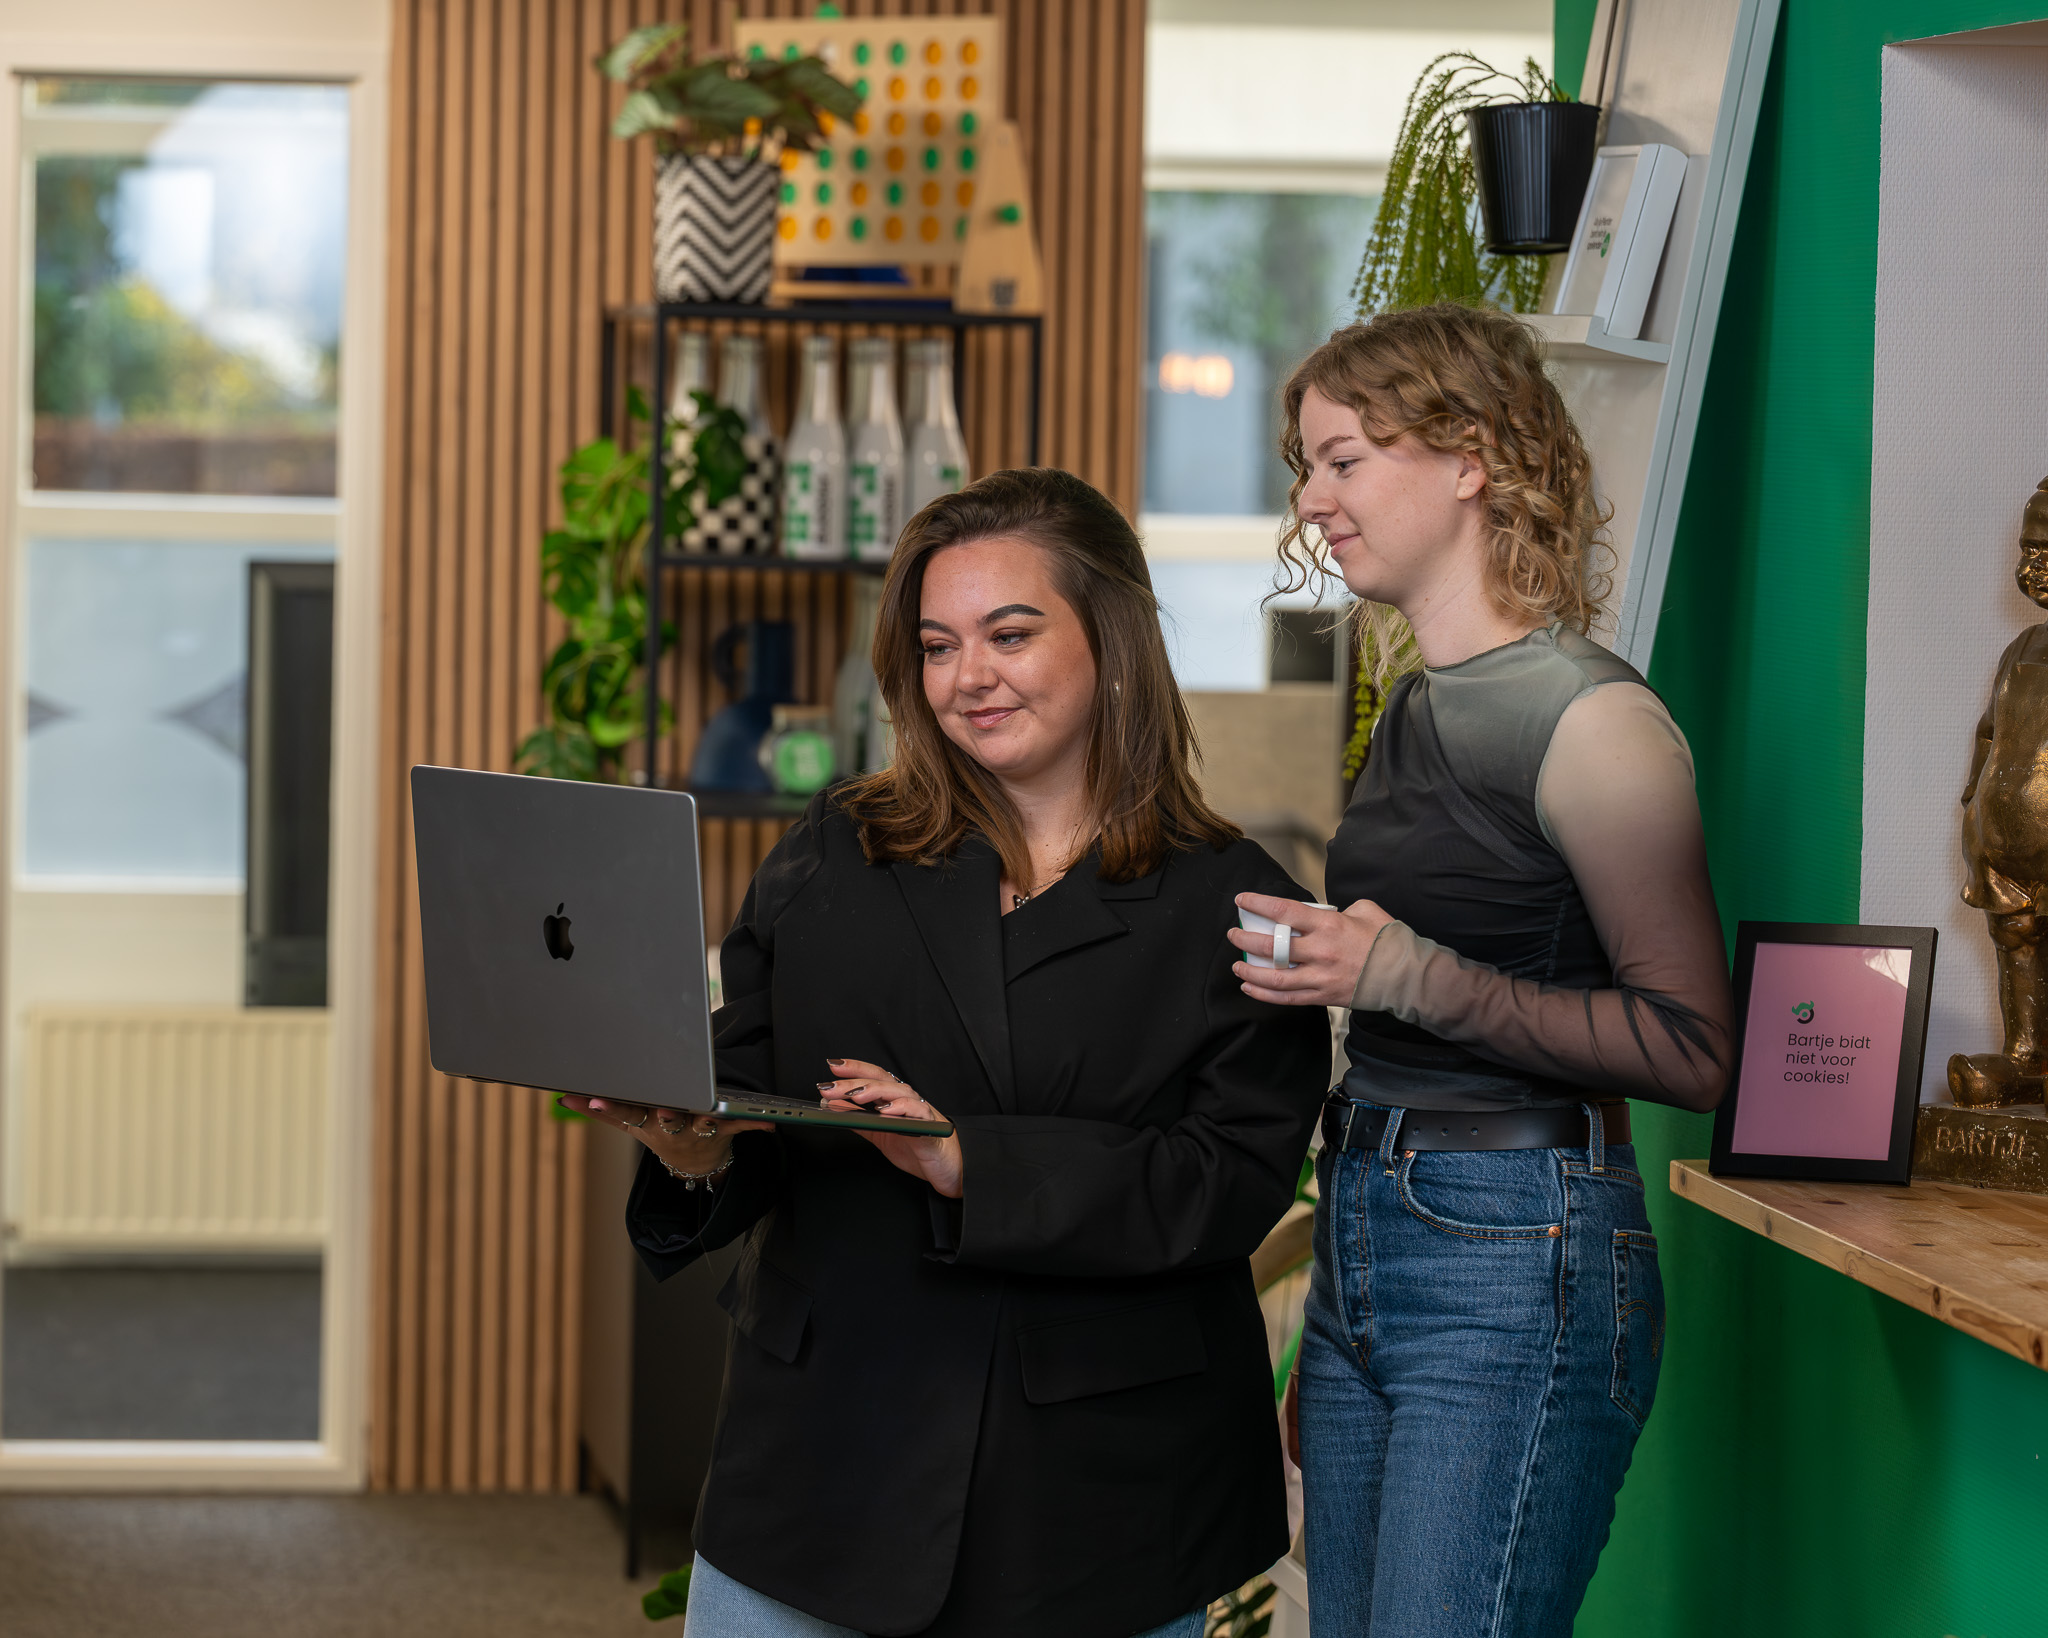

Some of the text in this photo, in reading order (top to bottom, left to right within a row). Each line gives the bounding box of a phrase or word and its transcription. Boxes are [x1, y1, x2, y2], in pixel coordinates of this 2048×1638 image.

[1788, 1033, 1871, 1051] Bartje bidt
[1785, 1051, 1856, 1067] niet voor
[1783, 1070, 1849, 1084] cookies!
[1935, 1126, 2037, 1162] BARTJE
